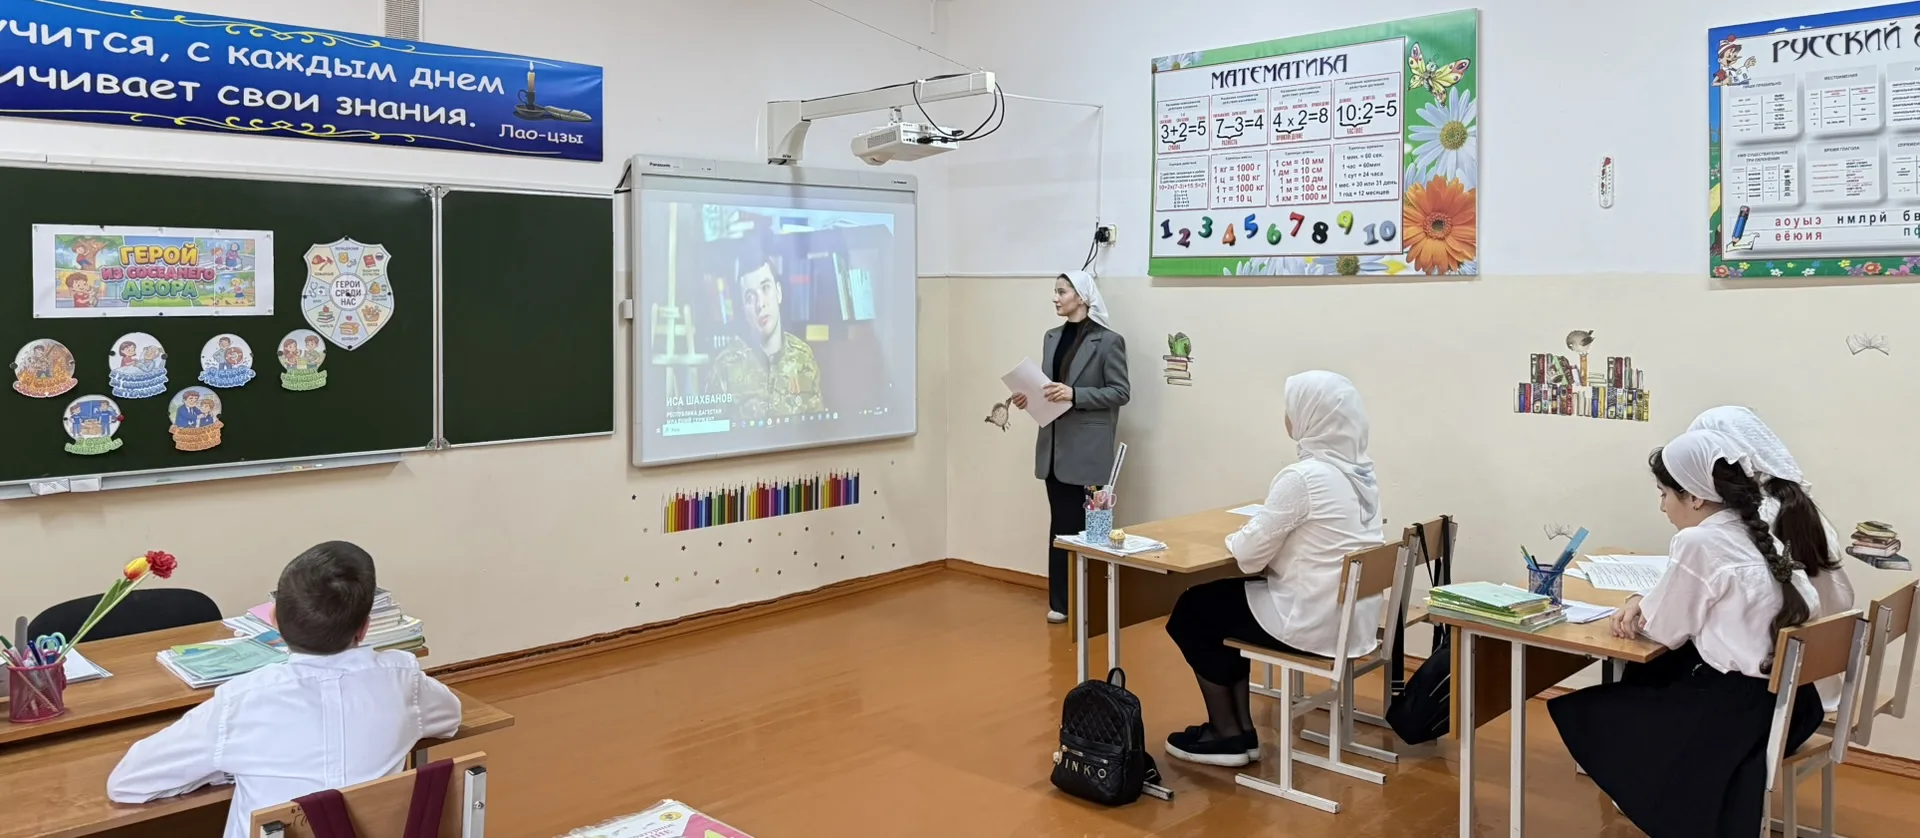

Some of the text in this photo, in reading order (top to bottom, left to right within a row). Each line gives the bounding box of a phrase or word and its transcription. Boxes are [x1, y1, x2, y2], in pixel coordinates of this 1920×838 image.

[1772, 21, 1901, 63] РУССКИЙ
[187, 42, 210, 62] с
[228, 45, 397, 83] каждым
[409, 67, 505, 95] днем
[1211, 54, 1348, 90] МАТЕМАТИКА
[217, 85, 320, 113] свои
[336, 96, 476, 128] знания.
[1336, 100, 1397, 122] 10:2=5
[498, 124, 584, 144] Лао-цзы
[1161, 120, 1206, 140] 3+2=5
[1237, 163, 1254, 172] 1000
[1236, 183, 1254, 192] 1000
[1237, 174, 1250, 182] 100
[1302, 192, 1318, 201] 1000
[1161, 210, 1396, 248] 1 2 3 4 5 6 7 8 9 10
[119, 243, 198, 266] ГЕРОЙ
[101, 266, 215, 281] ИЗ СОСЕДНЕГО
[121, 280, 198, 301] ДВОРА
[340, 298, 356, 306] НАС
[666, 393, 732, 407] ИСА ШАХБАНОВ
